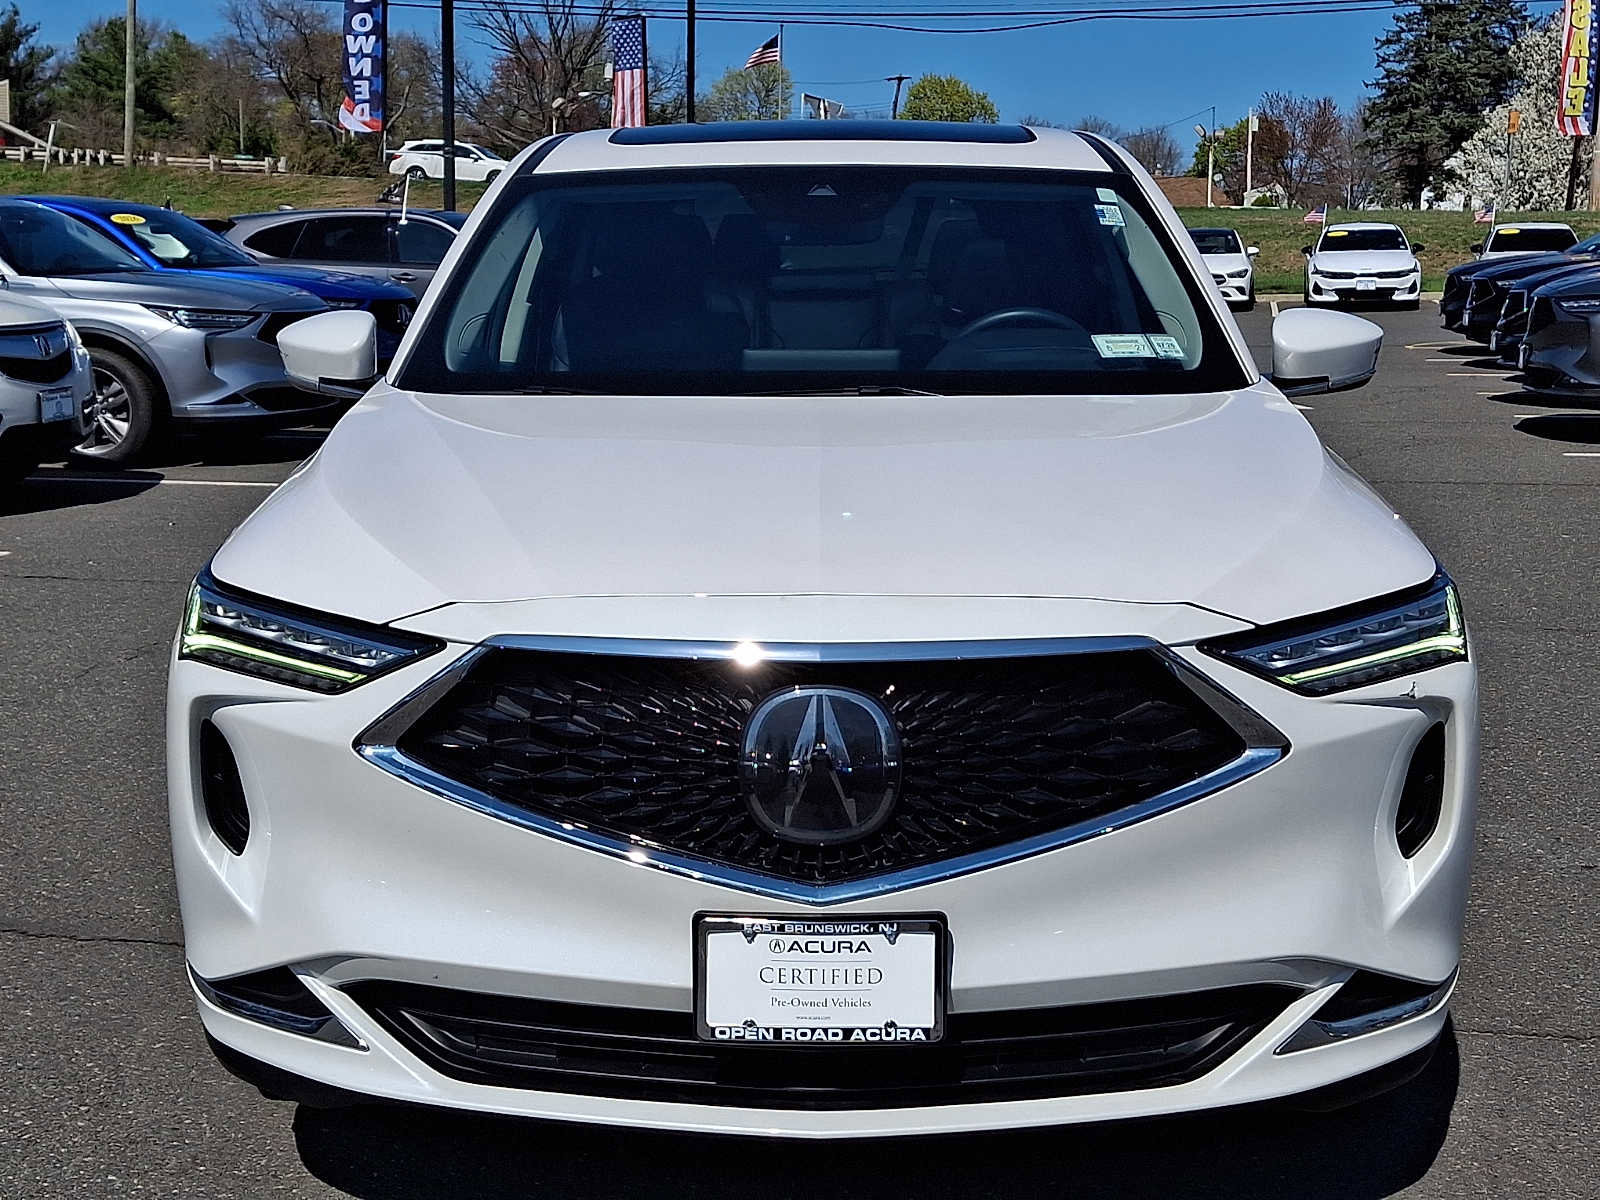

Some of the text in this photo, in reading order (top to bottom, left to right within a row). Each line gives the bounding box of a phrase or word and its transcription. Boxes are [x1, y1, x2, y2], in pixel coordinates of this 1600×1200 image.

[744, 923, 897, 933] EAST BRUNSWICK, NJ
[786, 940, 872, 953] ACURA
[759, 966, 883, 985] CERTIFIED
[771, 996, 872, 1007] Pre-Owned Vehicles
[715, 1028, 926, 1041] OPEN ROAD ACURA
